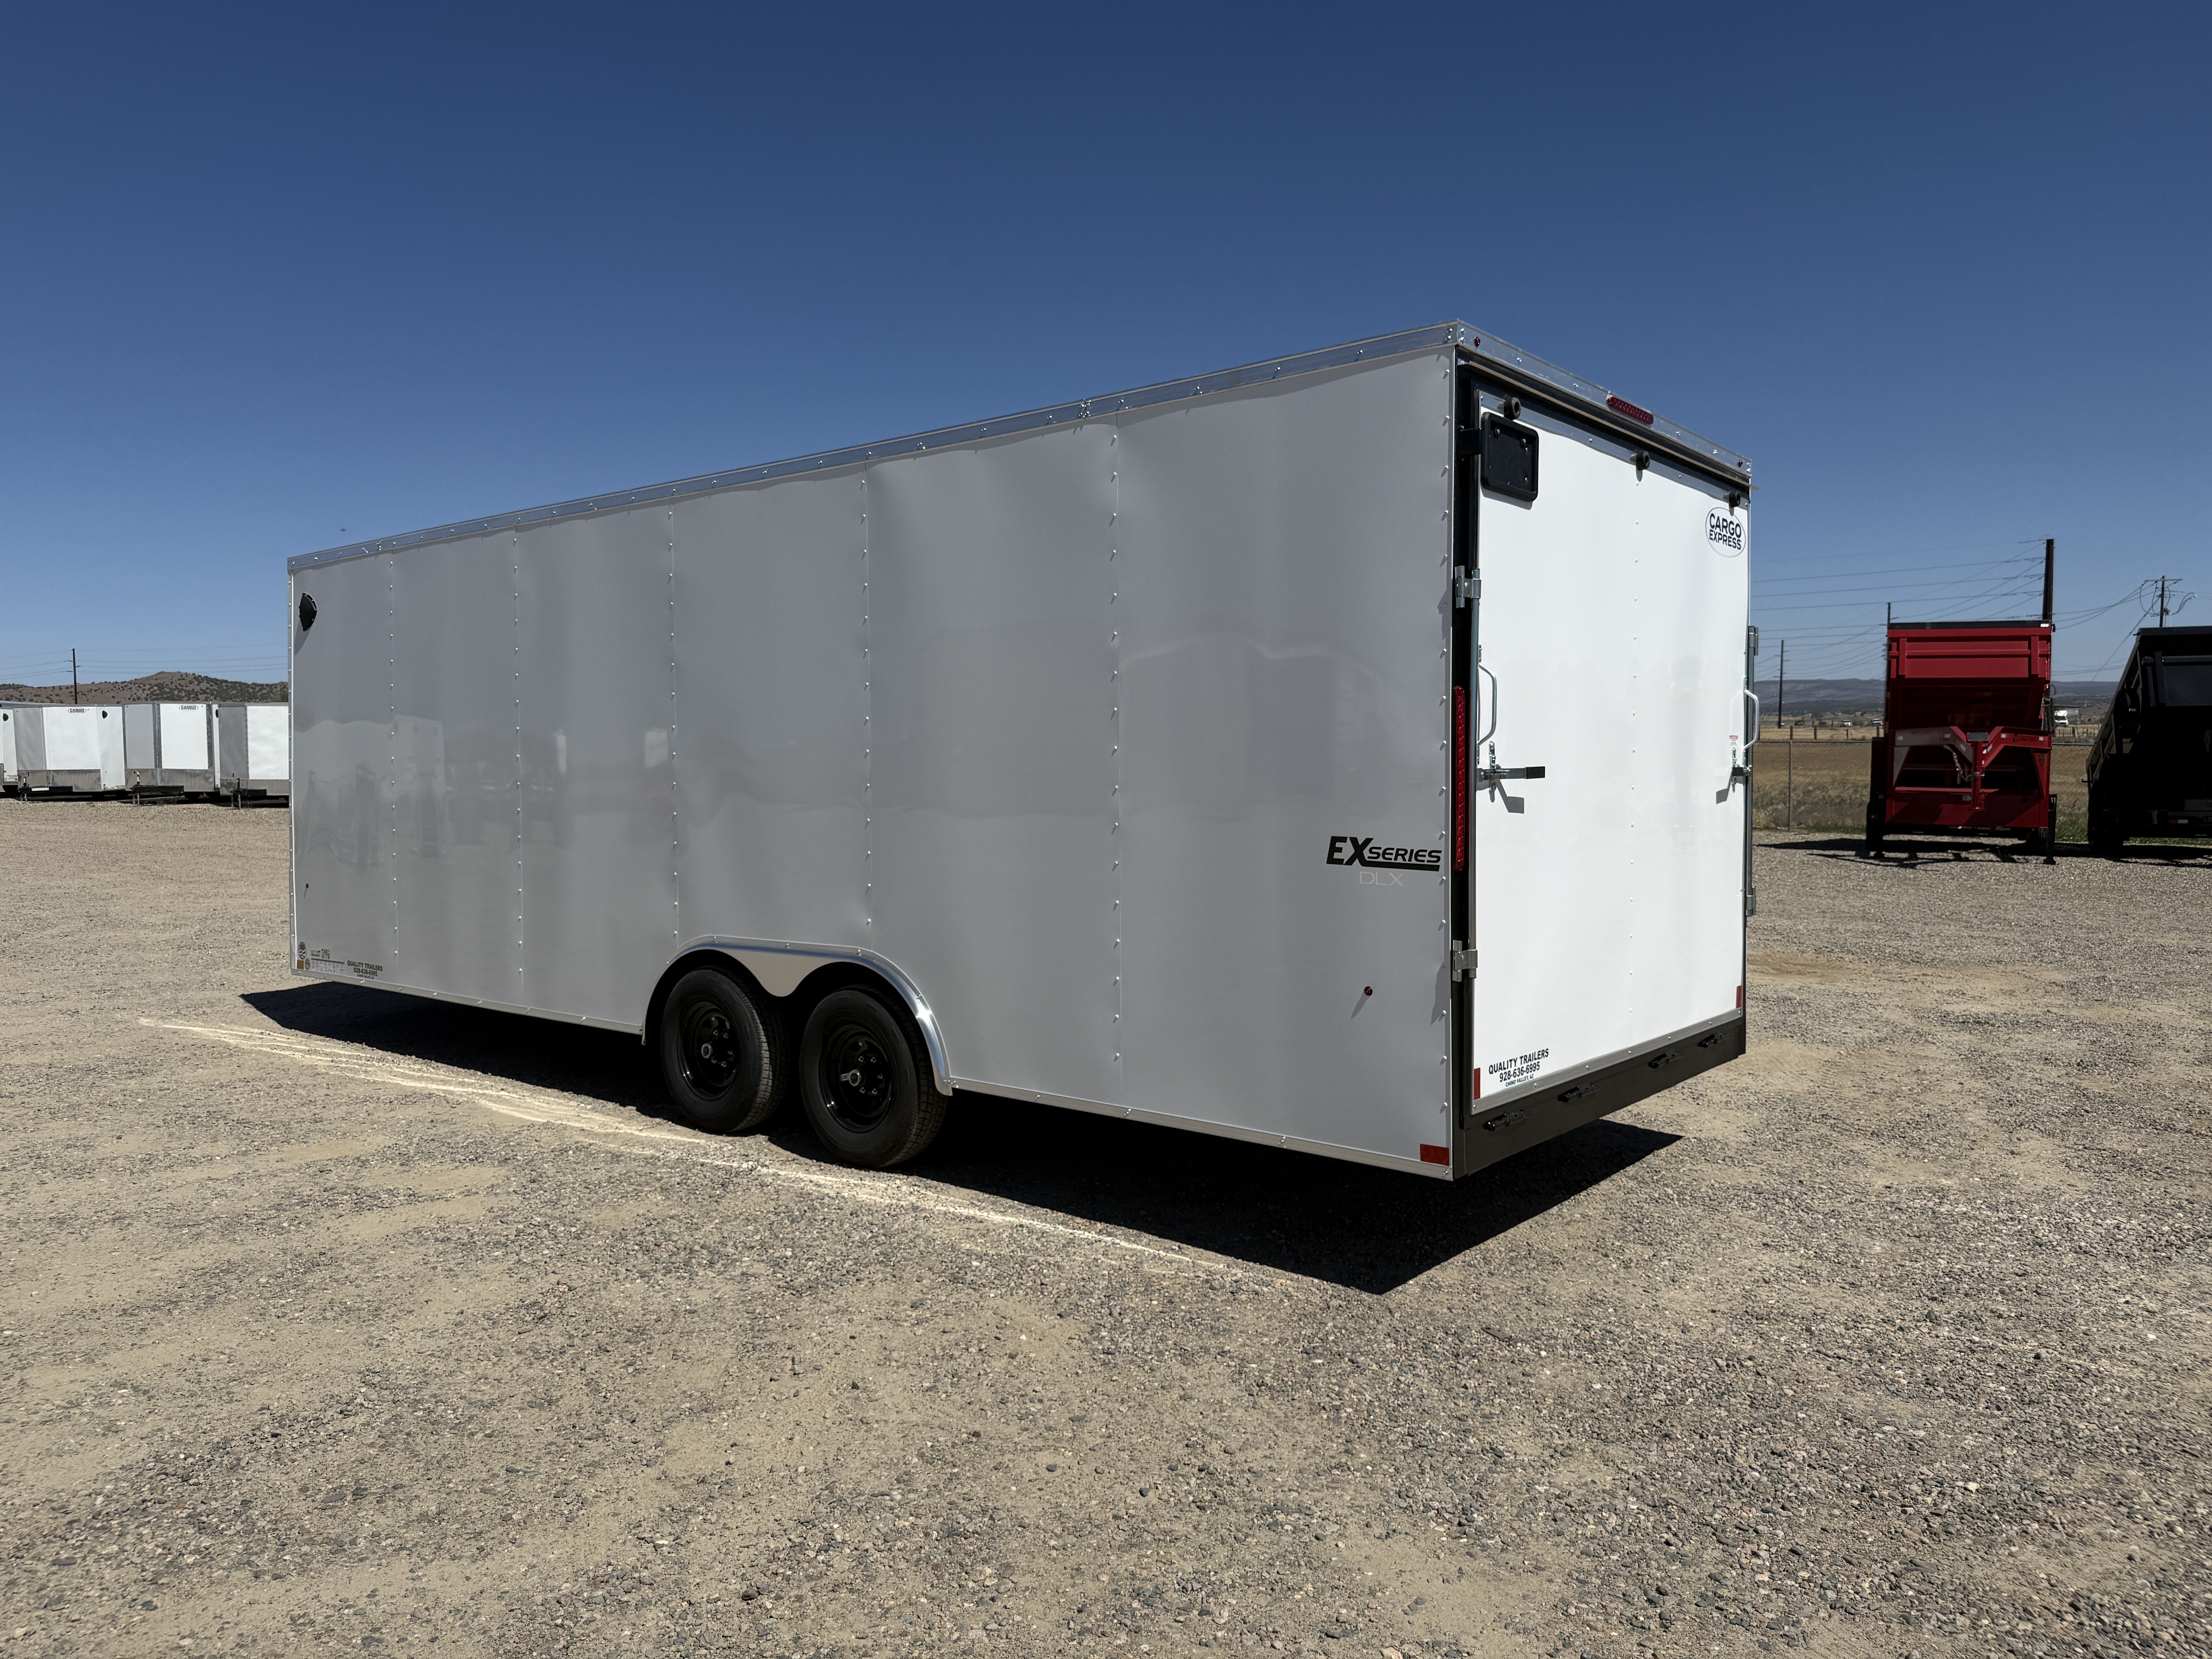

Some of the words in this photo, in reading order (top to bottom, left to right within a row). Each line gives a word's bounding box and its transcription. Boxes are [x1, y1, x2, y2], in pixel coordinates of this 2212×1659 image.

[1709, 513, 1741, 538] CARGO
[1709, 529, 1741, 550] EXPRESS
[1359, 871, 1404, 887] DLX
[364, 963, 383, 972] TRAILERS
[1489, 1057, 1518, 1074] QUALITY
[1519, 1048, 1549, 1065] TRAILERS
[1499, 1061, 1540, 1082] 928-636-6995
